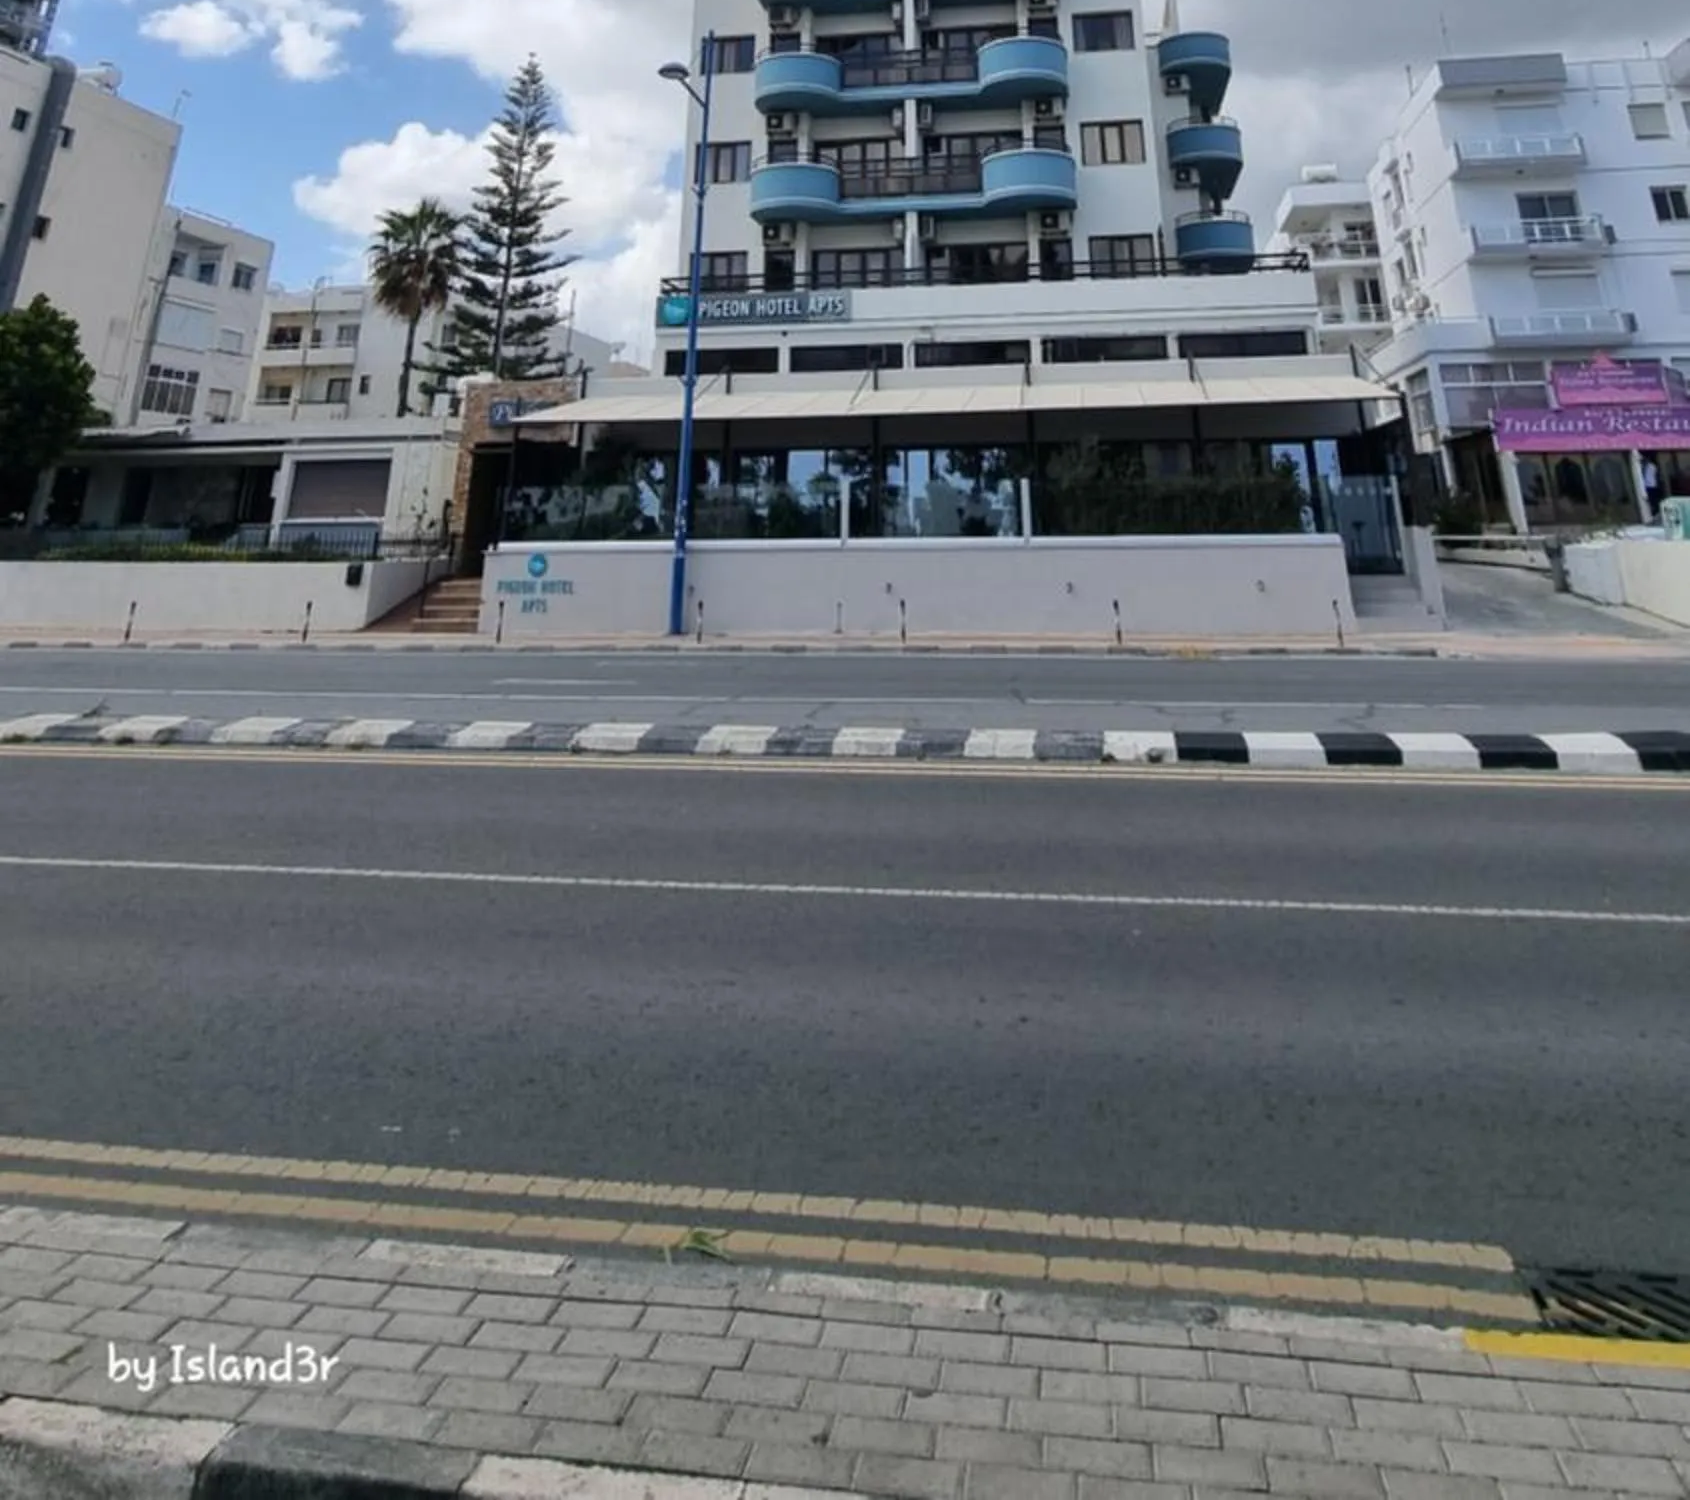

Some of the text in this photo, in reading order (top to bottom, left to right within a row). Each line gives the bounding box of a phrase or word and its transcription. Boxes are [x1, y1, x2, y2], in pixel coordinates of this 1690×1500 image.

[699, 295, 844, 318] PIGEON HOTEL APTS
[1503, 416, 1594, 433] Indian
